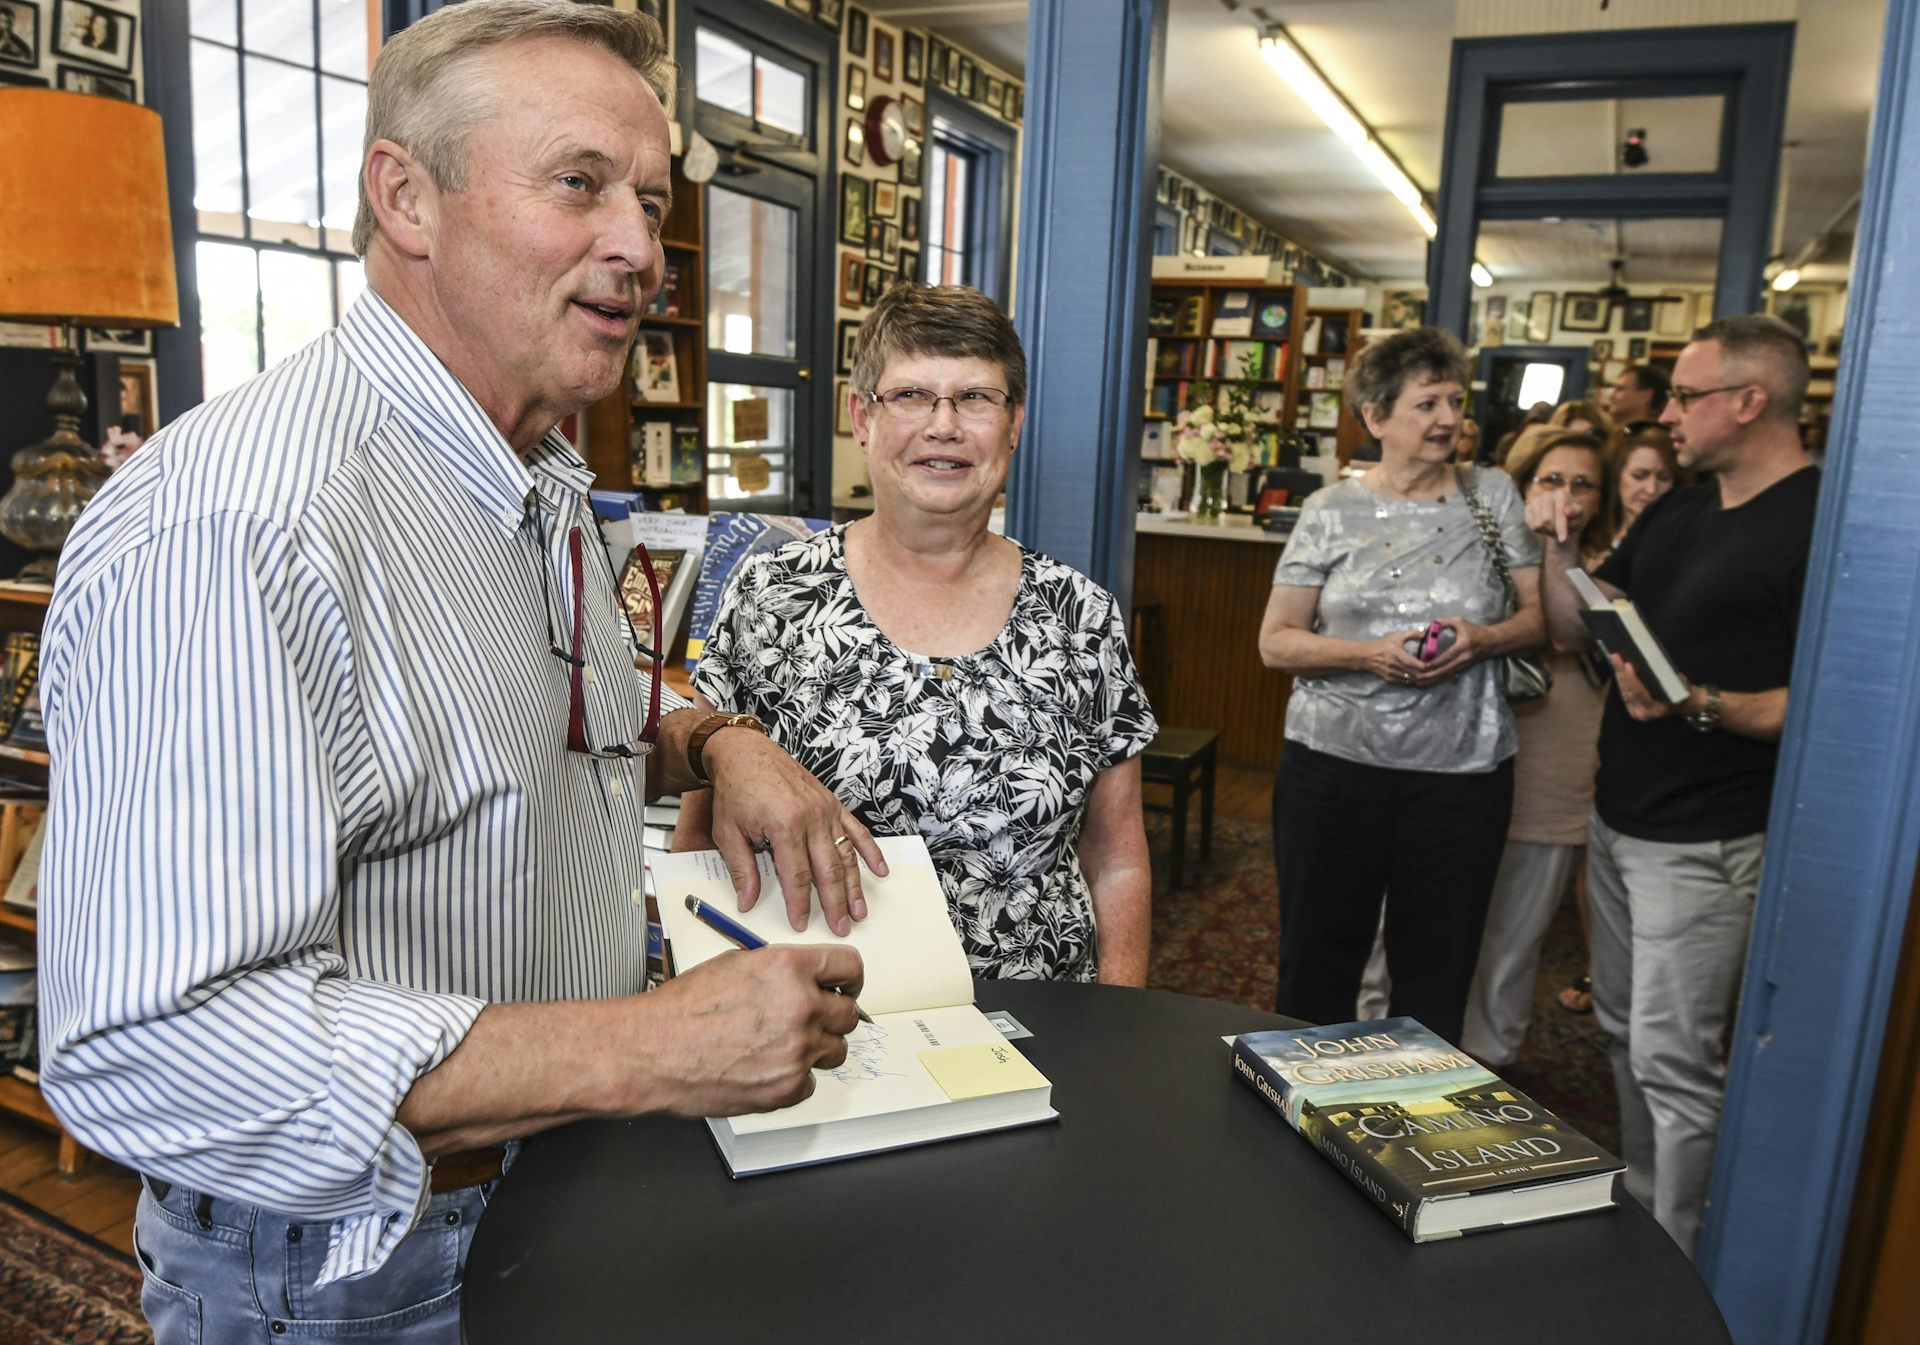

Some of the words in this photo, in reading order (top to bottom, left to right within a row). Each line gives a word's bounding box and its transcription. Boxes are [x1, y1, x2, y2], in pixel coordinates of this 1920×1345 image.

[1292, 1033, 1400, 1059] JOHN
[1234, 1053, 1256, 1082] JOHN
[1256, 1074, 1294, 1116] GRISHAM
[1290, 1053, 1473, 1085] GRISHAM
[1358, 1104, 1534, 1140] CAMINO
[1404, 1137, 1562, 1172] ISLAND
[1504, 1166, 1529, 1174] NOVEL
[1350, 1159, 1387, 1202] ISLAND
